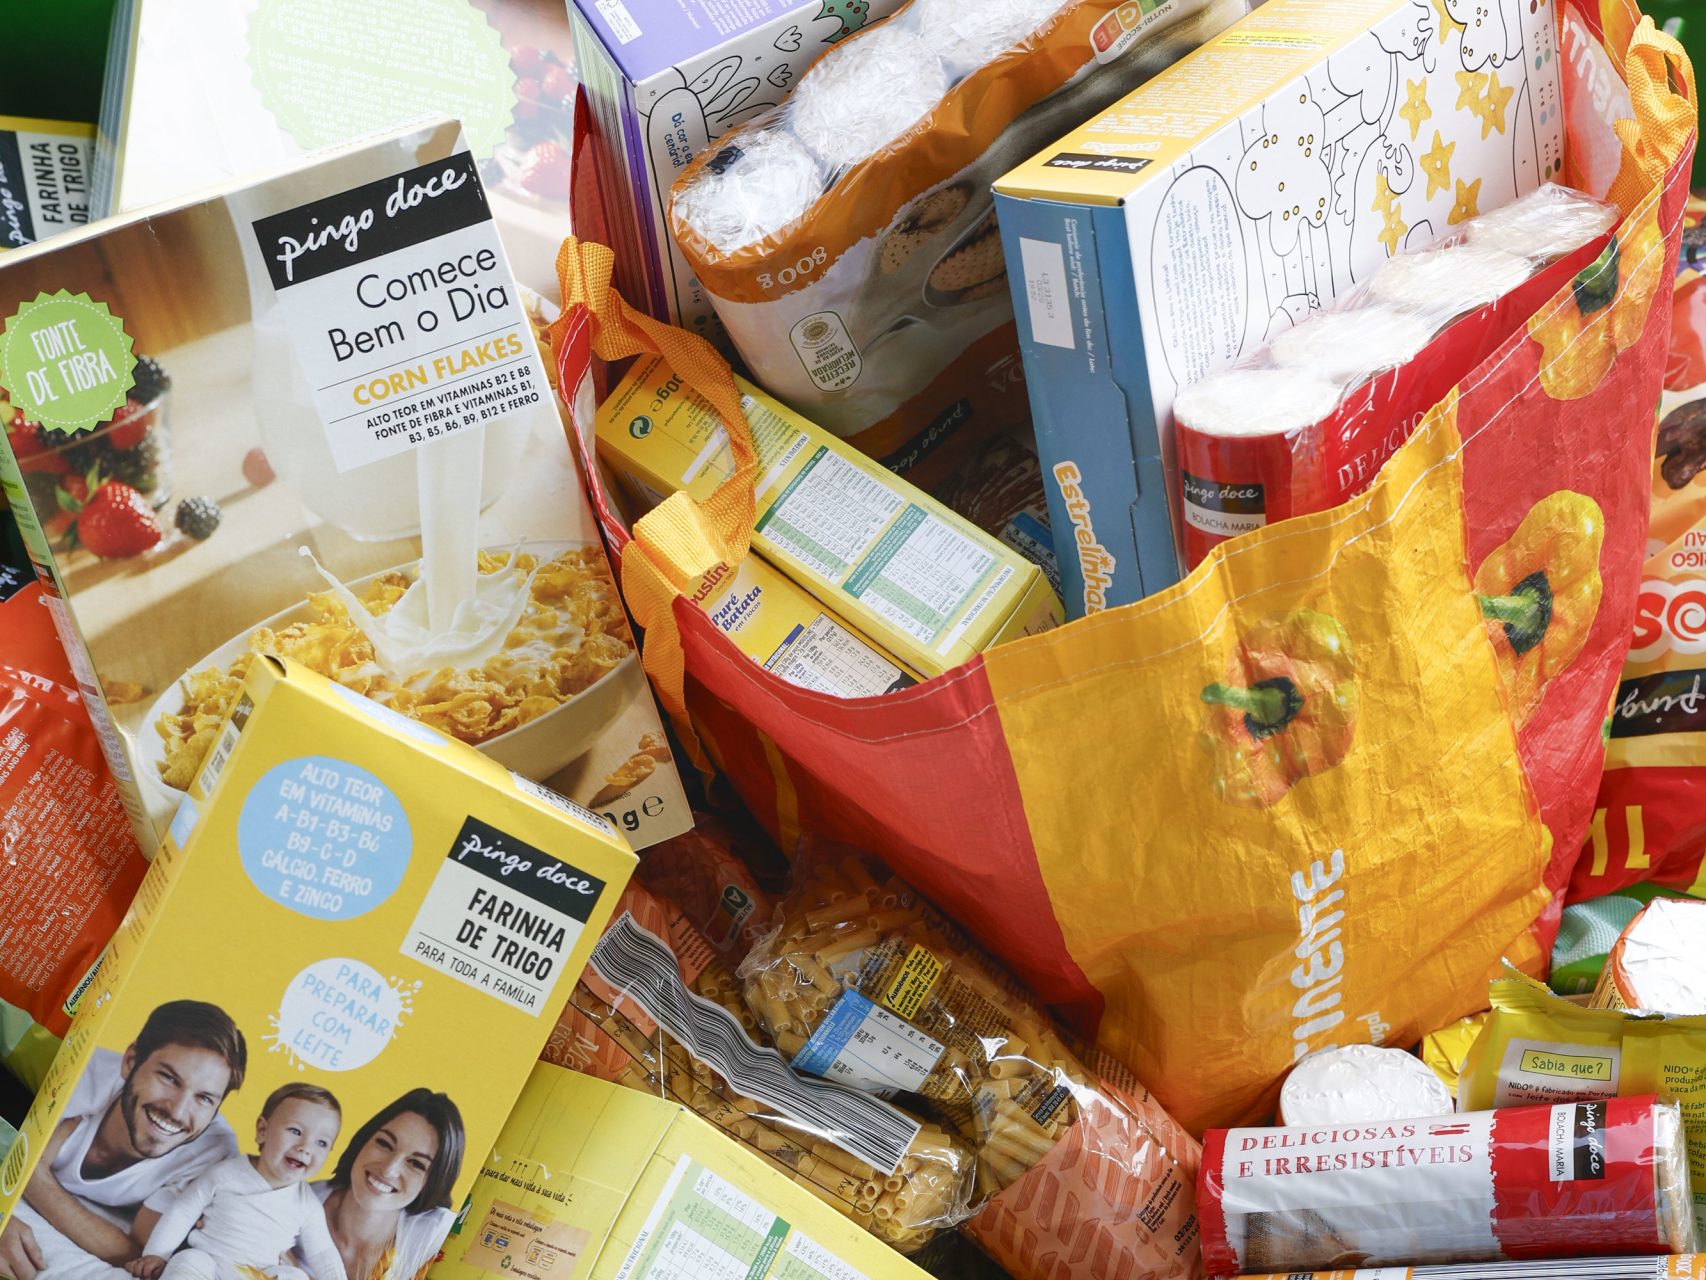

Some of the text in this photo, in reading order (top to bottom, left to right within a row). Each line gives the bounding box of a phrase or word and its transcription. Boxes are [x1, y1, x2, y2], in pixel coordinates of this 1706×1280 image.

[664, 133, 685, 169] cenário!
[1094, 158, 1147, 169] pingo
[30, 141, 64, 224] FARINHA
[58, 144, 88, 225] DE TRIGO
[277, 168, 467, 281] pingo doce
[357, 248, 496, 308] Comece
[777, 246, 828, 285] 800
[30, 320, 87, 362] FONTE
[328, 284, 509, 362] Bem o Dia
[26, 348, 117, 406] DE FIBRA
[353, 333, 523, 405] CORN FLAKES
[811, 349, 856, 378] MELHORADA
[820, 361, 857, 384] RECEITA
[366, 366, 531, 429] ALTO TEOR EM VITAMINAS B2 E B8
[375, 379, 536, 440] FONTE DE FIBRA E VITAMINAS B1,
[409, 392, 539, 444] B3, B5, B6, B9, B12 FERRO
[1184, 479, 1259, 502] pingo doce
[1192, 512, 1228, 529] BOLACHA
[712, 593, 739, 627] Puré
[722, 585, 762, 632] Batata
[743, 601, 761, 623] Flocos
[3, 727, 20, 746] CACAU
[7, 742, 31, 772] AND IRON
[280, 780, 305, 800] EM
[300, 762, 384, 807] ALTO TEOR
[323, 868, 372, 897] FERRO
[458, 835, 595, 896] pingo doce
[279, 880, 289, 897] E
[40, 909, 59, 933] barley
[467, 887, 568, 954] FARINHA
[456, 918, 554, 982] DE TRIGO
[336, 964, 383, 1003] PARA
[415, 940, 537, 1009] PARA TODA A FAMÍLIA
[301, 973, 391, 1037] PREPARAR
[312, 1011, 352, 1044] COM
[292, 1028, 344, 1067] LEITE
[1532, 1056, 1603, 1075] Sabia que?
[1542, 1085, 1574, 1096] fabricado
[1240, 1124, 1416, 1152] DELICIOSAS
[1555, 1112, 1567, 1176] BOLACHA MARIA
[1578, 1103, 1600, 1175] pingo doce
[1238, 1144, 1473, 1178] E IRRESISTÍVEIS
[485, 1168, 566, 1203] para vida sua vida
